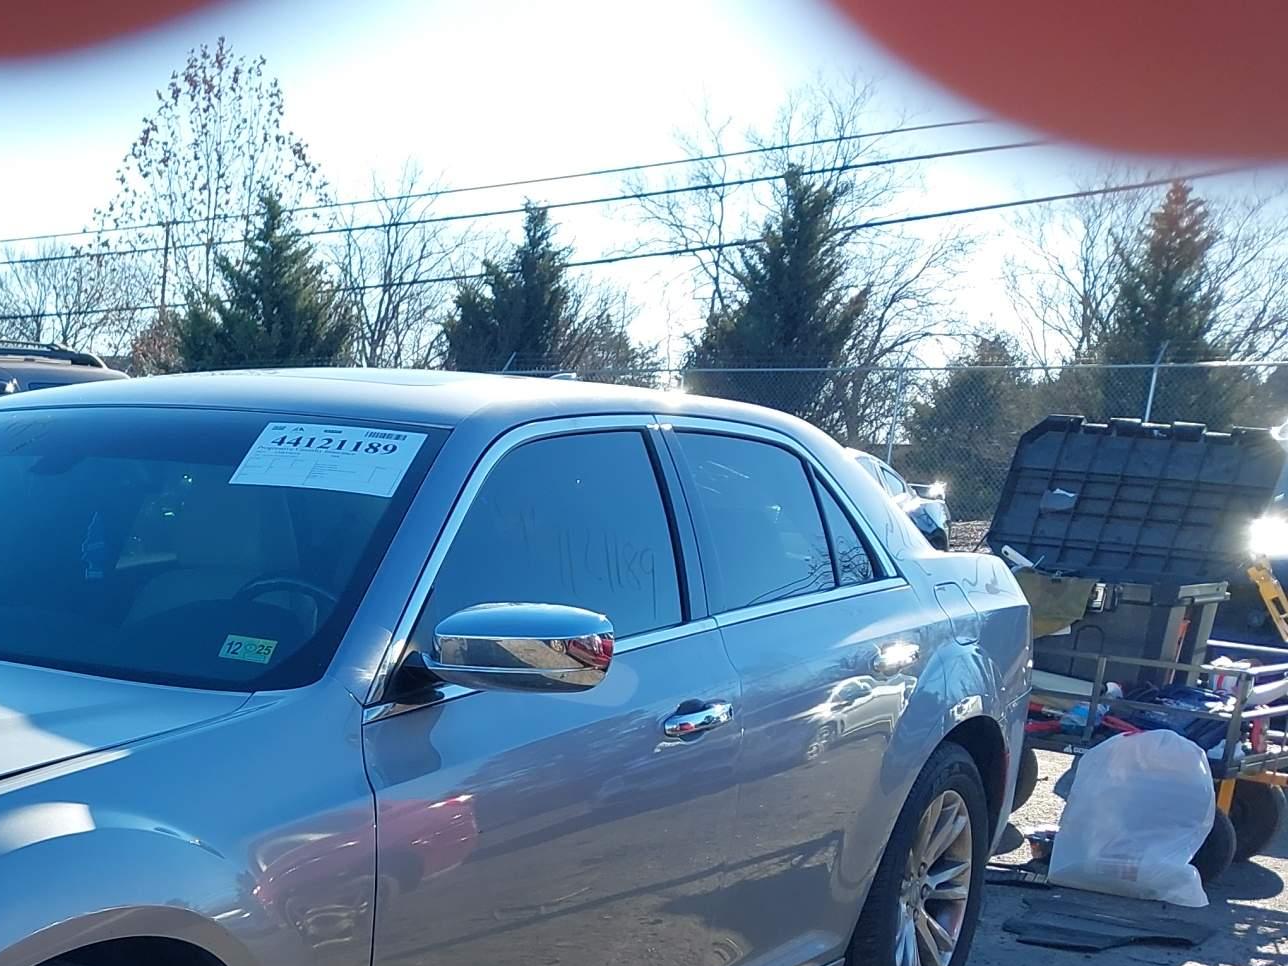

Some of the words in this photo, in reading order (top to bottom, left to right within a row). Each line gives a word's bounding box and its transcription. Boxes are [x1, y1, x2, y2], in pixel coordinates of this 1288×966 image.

[271, 435, 399, 456] 44121189
[226, 640, 242, 655] 12
[256, 644, 272, 656] 25
